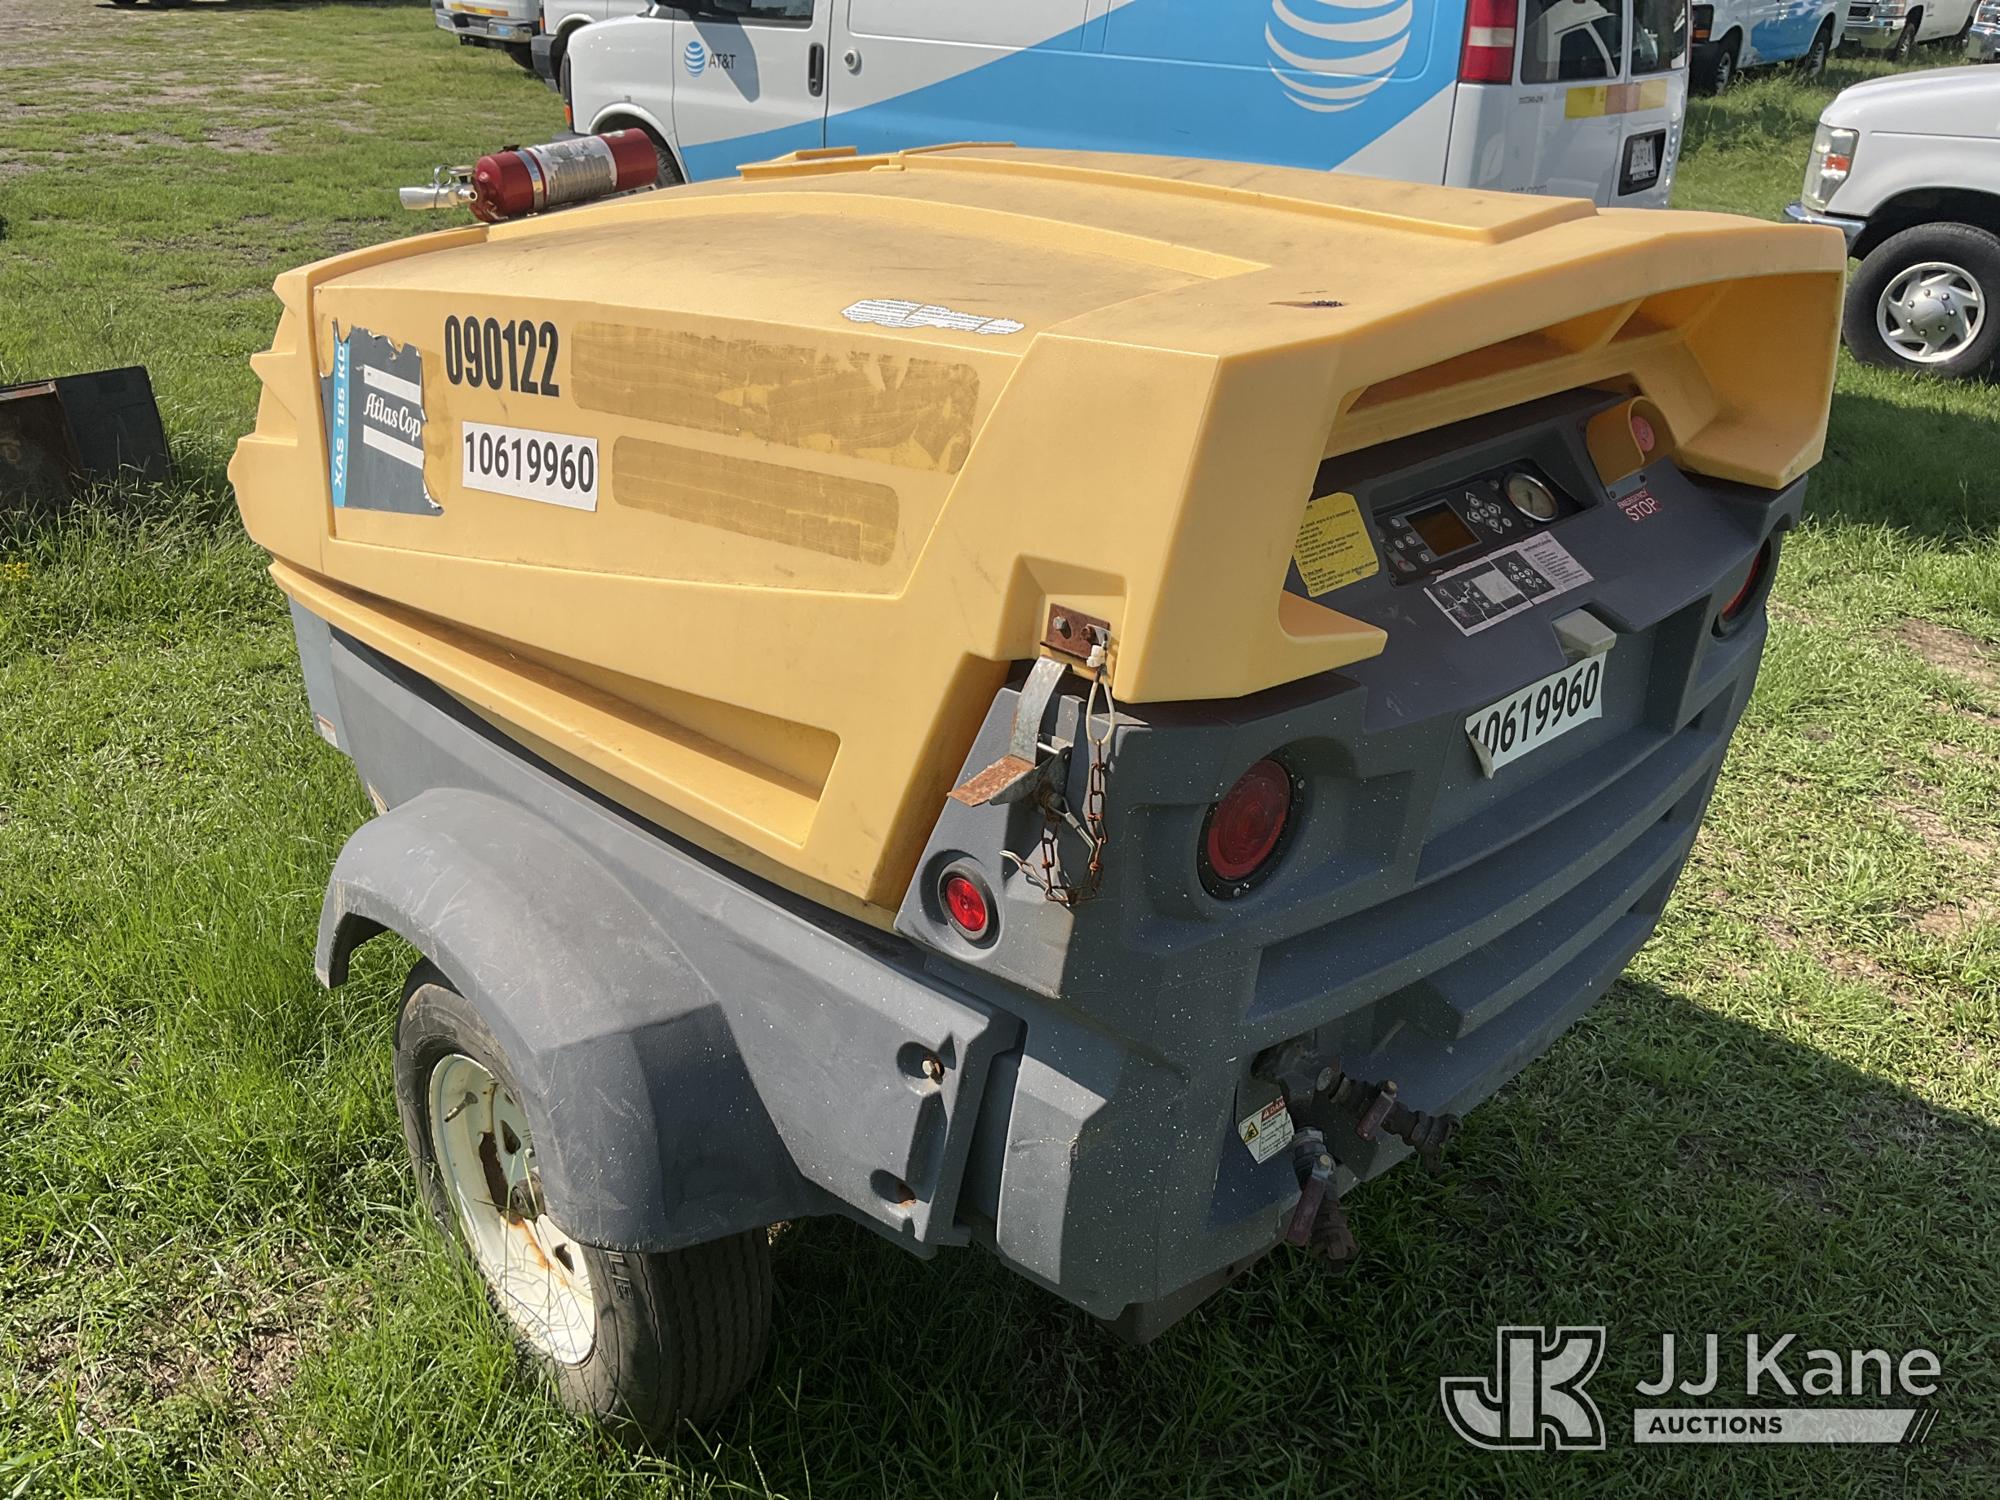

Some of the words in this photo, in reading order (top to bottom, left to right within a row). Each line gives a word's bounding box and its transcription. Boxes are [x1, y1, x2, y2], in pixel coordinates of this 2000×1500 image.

[708, 53, 737, 69] AT&T
[444, 314, 560, 398] 090122
[336, 386, 346, 428] 185
[363, 392, 399, 428] Atlas
[398, 405, 421, 442] Cop
[334, 437, 346, 489] XAS
[465, 431, 595, 493] 10619960
[1625, 497, 1657, 521] STOP
